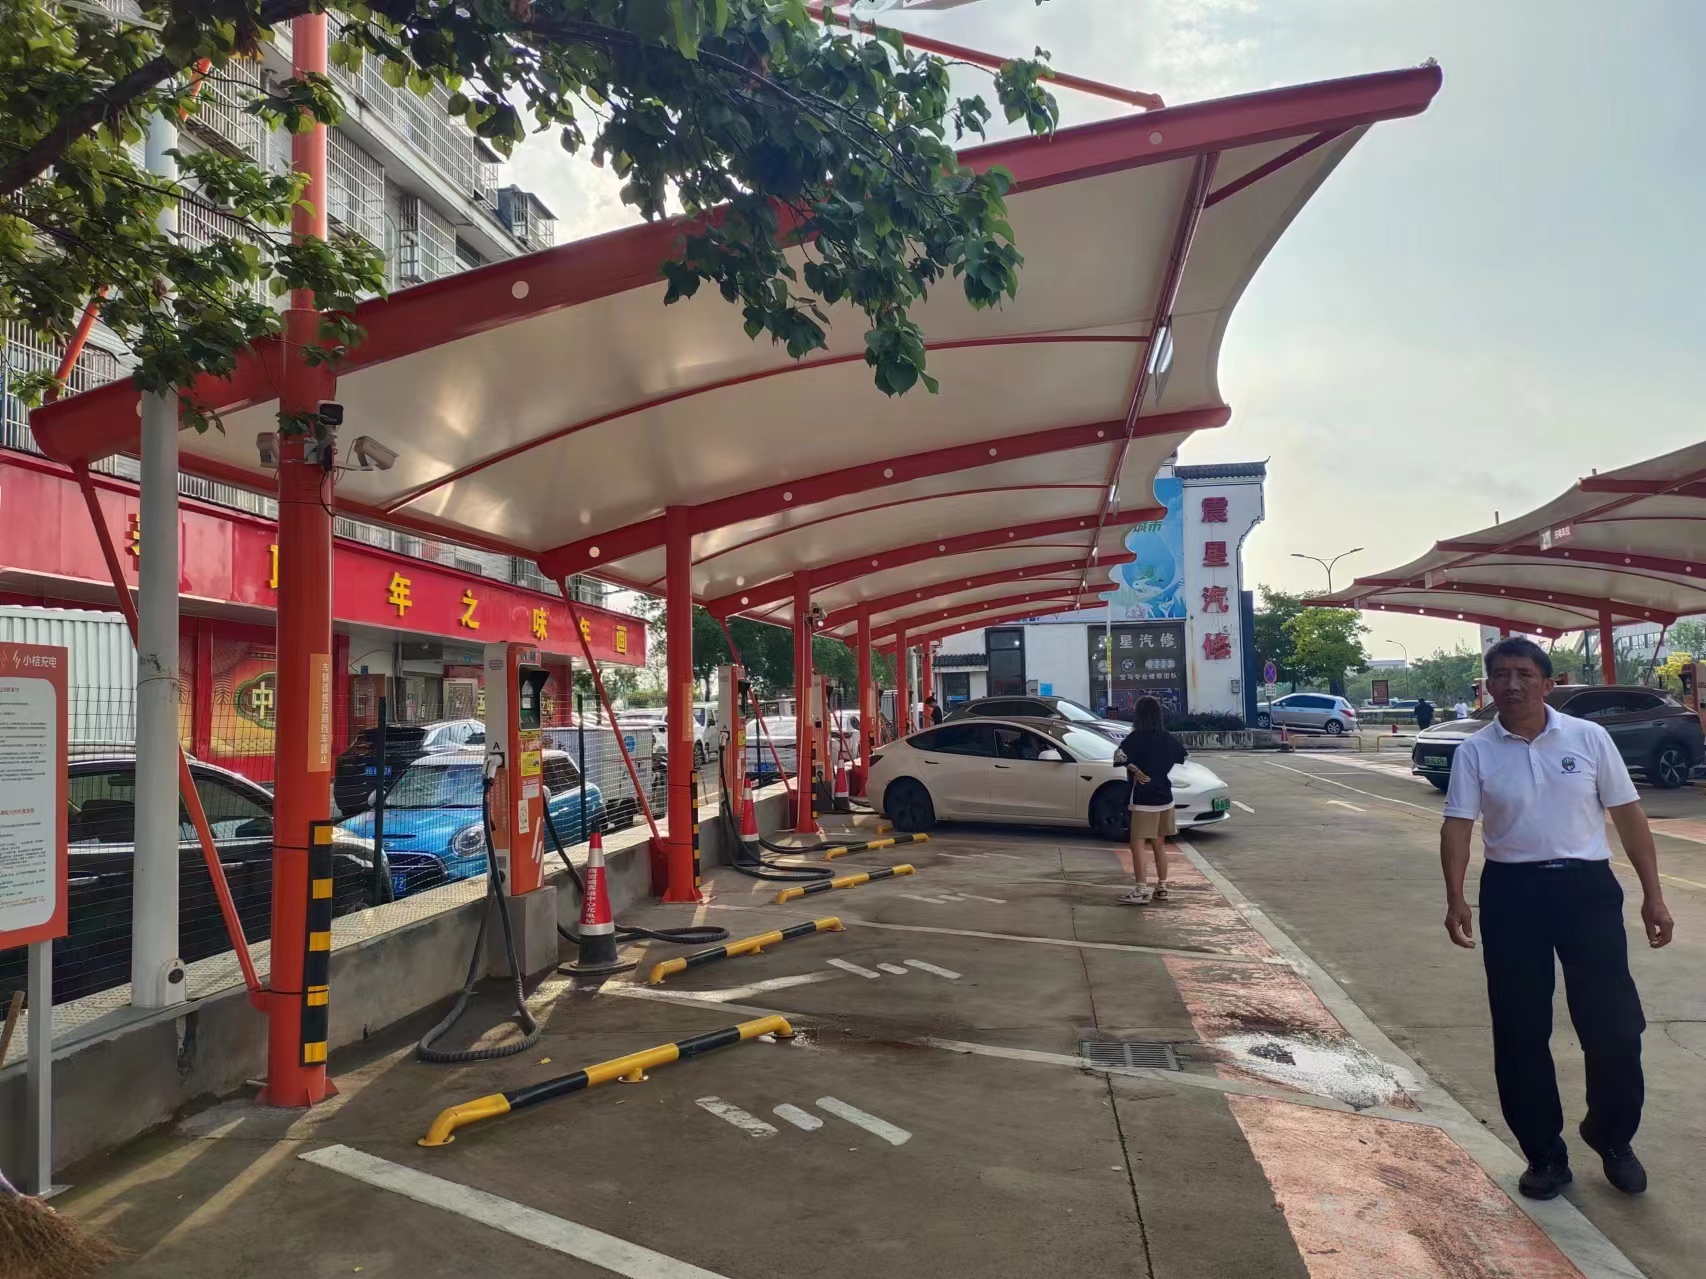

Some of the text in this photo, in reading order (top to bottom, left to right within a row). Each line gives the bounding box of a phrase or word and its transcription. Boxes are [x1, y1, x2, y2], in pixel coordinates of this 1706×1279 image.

[1201, 496, 1231, 661] 震星汽修
[23, 654, 57, 668] 小桔充电
[493, 742, 501, 750] A
